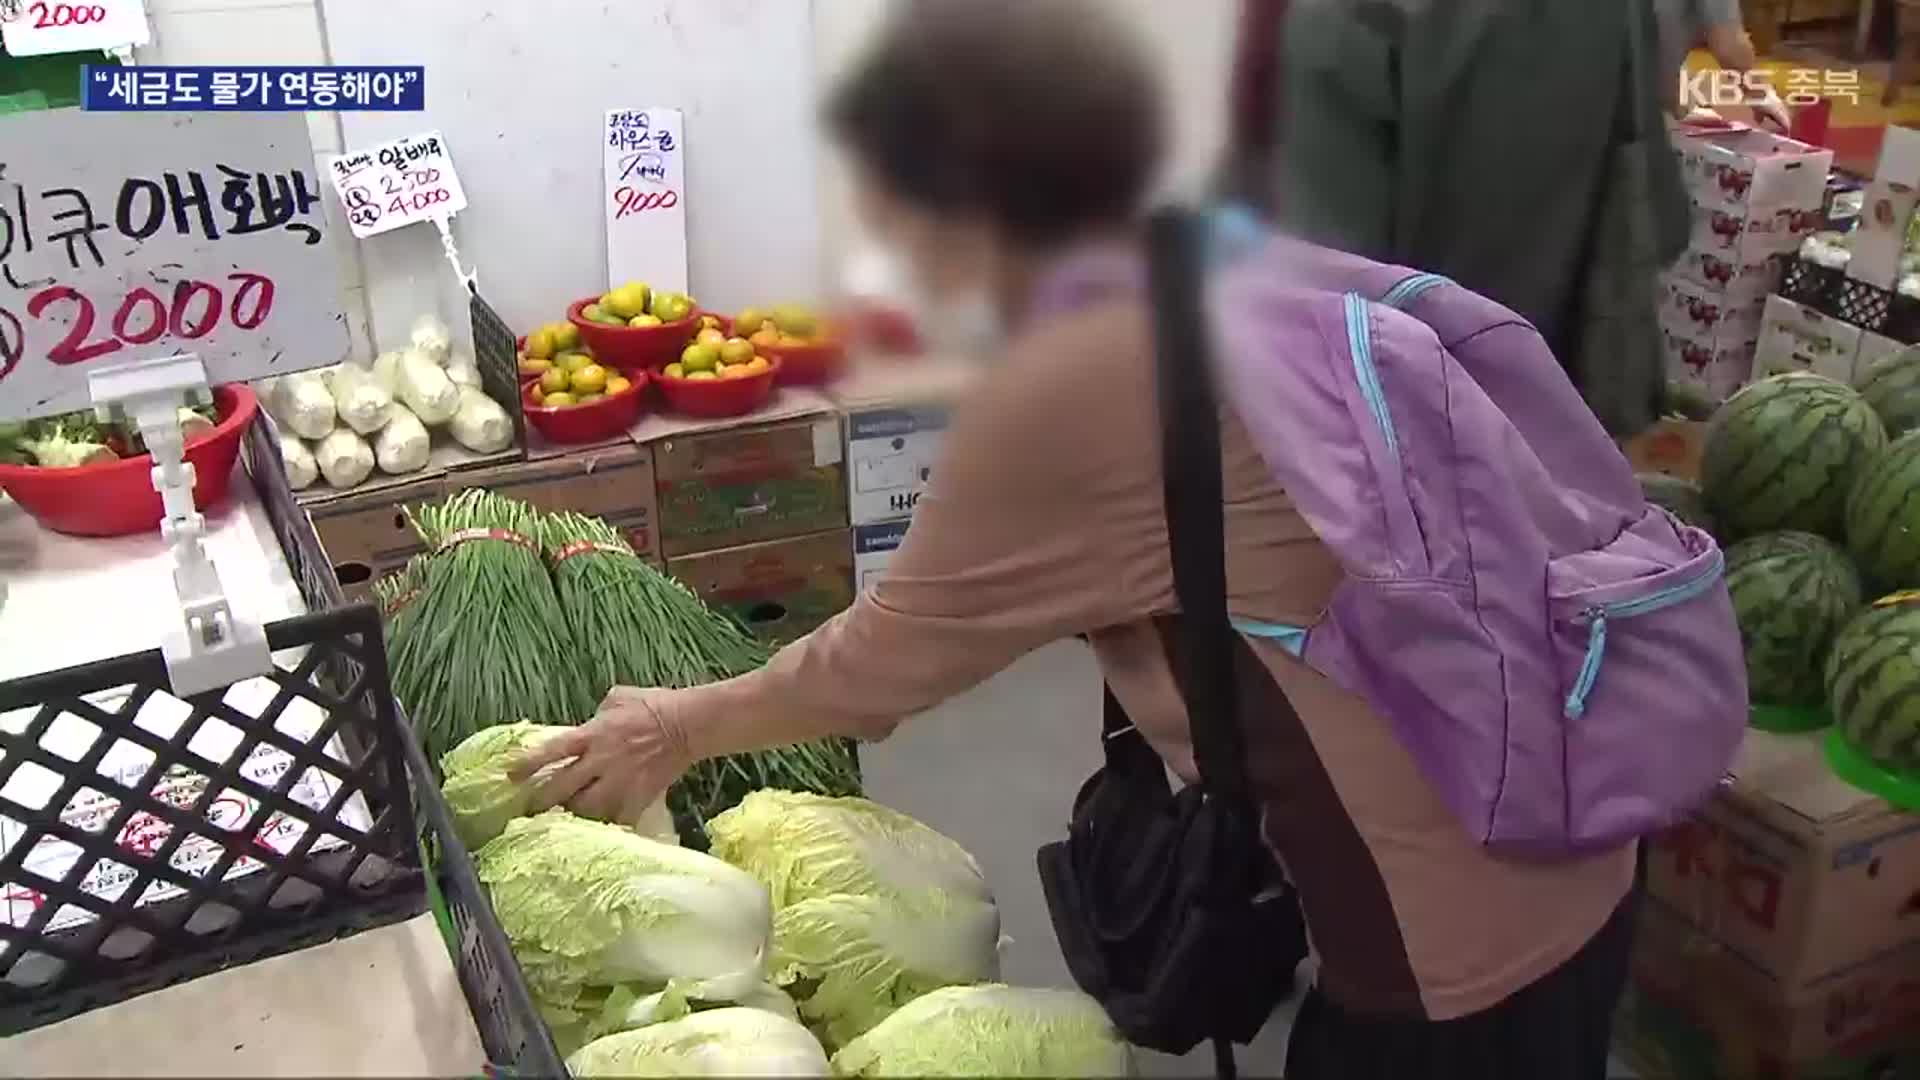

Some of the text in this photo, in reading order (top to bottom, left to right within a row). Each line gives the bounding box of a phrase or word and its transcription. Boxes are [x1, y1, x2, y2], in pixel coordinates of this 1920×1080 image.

[28, 2, 105, 29] 2000
[115, 163, 322, 245] 애호박
[27, 272, 275, 366] 2000
